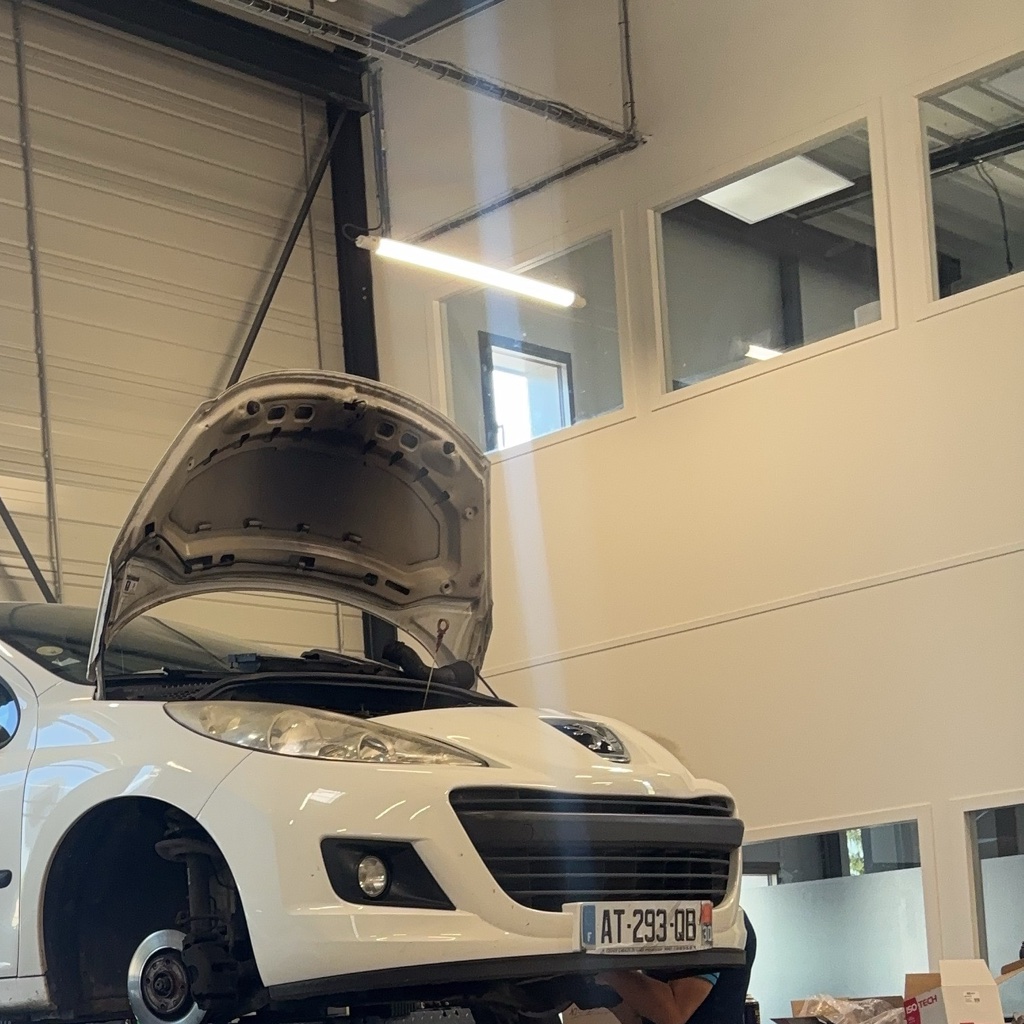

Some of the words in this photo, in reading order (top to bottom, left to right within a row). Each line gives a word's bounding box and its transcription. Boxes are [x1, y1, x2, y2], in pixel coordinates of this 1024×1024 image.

[601, 908, 696, 943] AT-293-QB
[587, 931, 593, 942] F
[906, 1003, 918, 1014] ISO
[918, 995, 938, 1008] TECH
